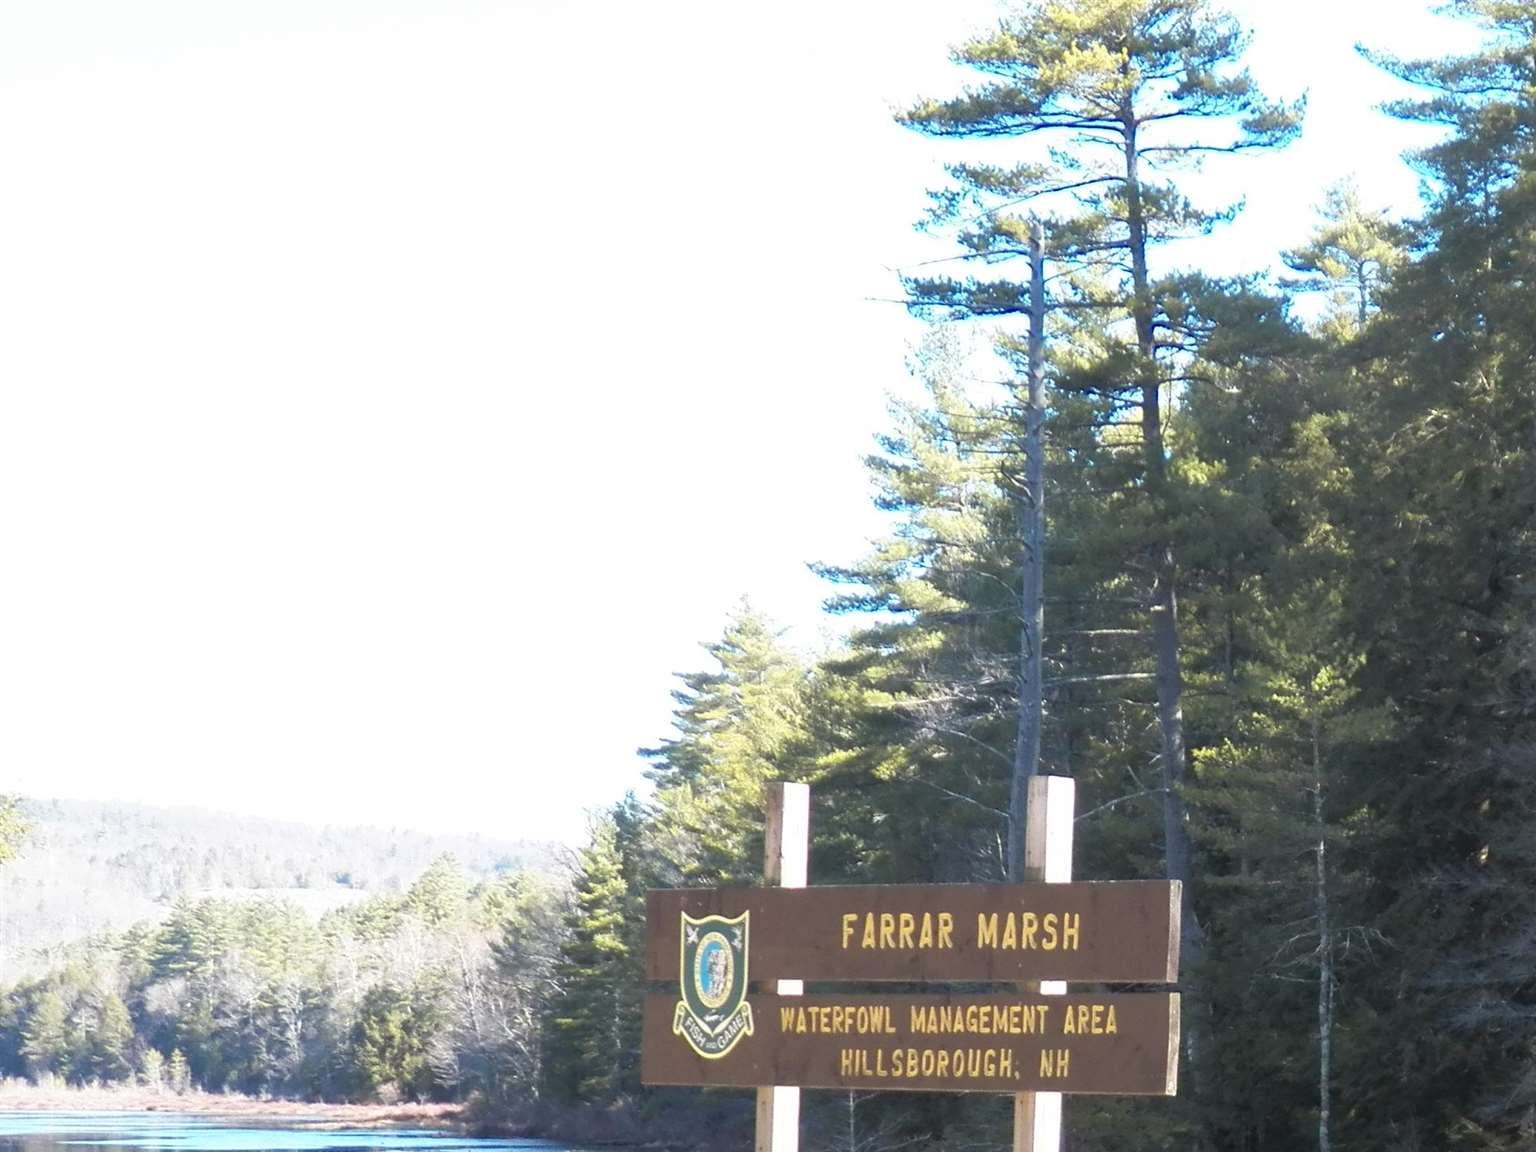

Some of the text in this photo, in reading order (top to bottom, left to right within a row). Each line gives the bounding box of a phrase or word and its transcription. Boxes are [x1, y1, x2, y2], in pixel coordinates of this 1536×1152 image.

[842, 912, 1080, 950] FARRAR MARSH
[685, 1014, 744, 1049] FISH GAME
[780, 1005, 1117, 1035] WATERFOWL MANAGEMENT AREA
[1039, 1049, 1070, 1078] NH
